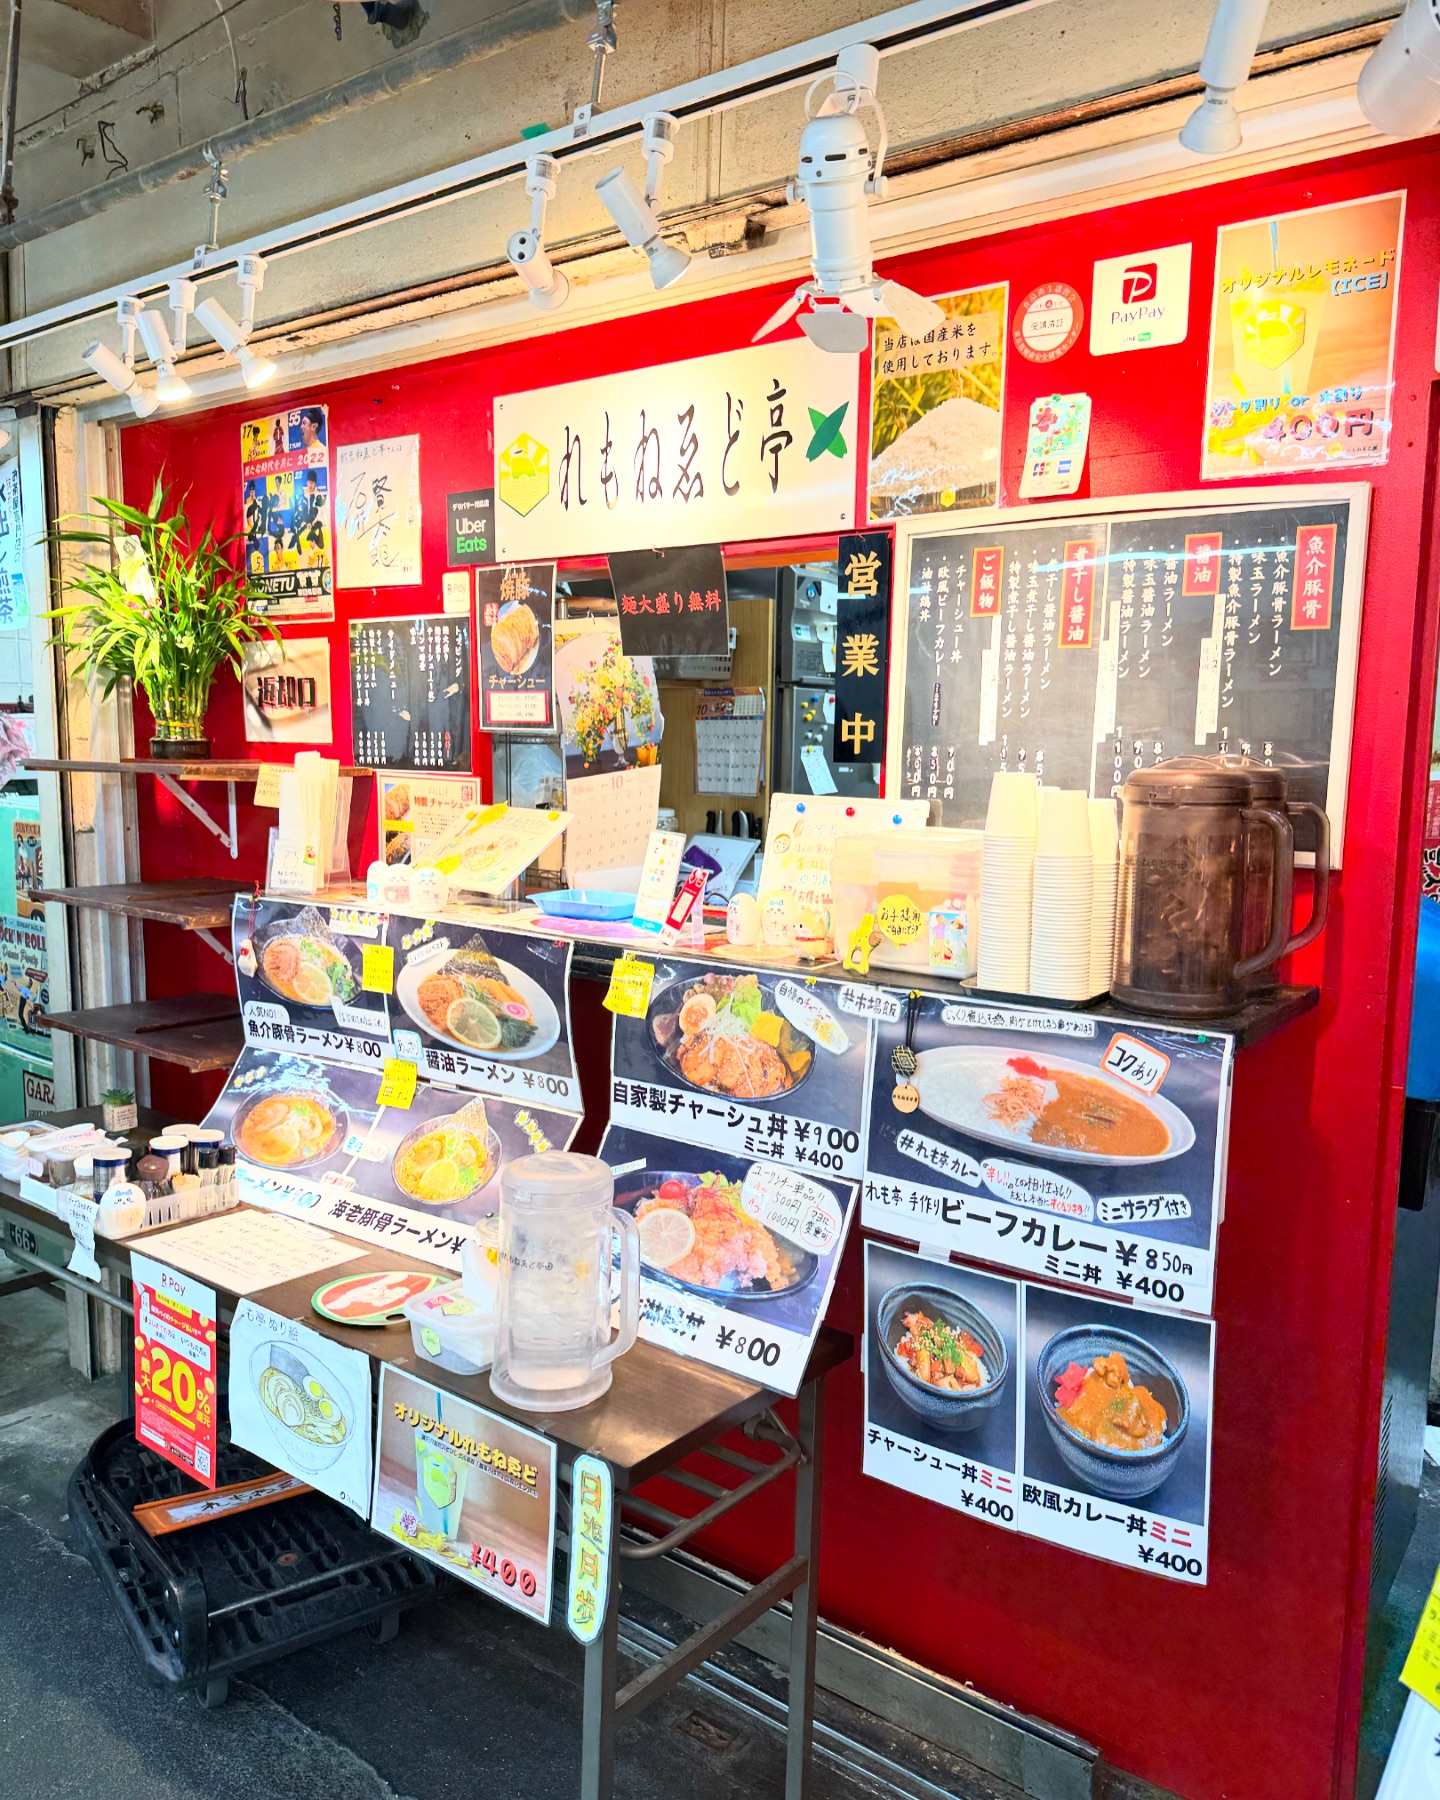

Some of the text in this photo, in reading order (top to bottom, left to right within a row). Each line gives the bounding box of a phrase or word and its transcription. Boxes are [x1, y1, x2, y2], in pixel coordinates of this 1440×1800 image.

[1221, 249, 1396, 293] オリジナルレモネード
[1111, 305, 1166, 325] PayPay
[883, 323, 977, 352] 当店は国産米を
[882, 342, 997, 374] 使用しております。
[1290, 395, 1309, 407] or
[243, 425, 252, 439] 17
[288, 411, 301, 426] 55
[1263, 408, 1374, 442] 400円
[297, 452, 324, 466] 2022
[559, 379, 793, 511] れもねゑど亭
[456, 518, 486, 535] Uber
[457, 537, 487, 553] Eats
[978, 555, 997, 609] ご飯物
[1068, 546, 1089, 642] 煮干し醤油
[1302, 535, 1326, 620] 魚介豚骨
[621, 590, 722, 615] 麺大盛り無料
[1248, 550, 1268, 645] 味玉ラーメン
[934, 562, 949, 677] 欧風ビーフカレー
[950, 565, 967, 664] チャーシュー丼
[842, 551, 882, 754] 営業中
[257, 677, 316, 708] 返却口
[489, 674, 545, 689] チャーシュー
[697, 704, 708, 715] 10
[611, 775, 623, 790] 10
[426, 1050, 515, 1083] 醤油ラーメン
[522, 1071, 569, 1097] ¥800
[1106, 1045, 1158, 1086] コクあり
[614, 1081, 859, 1153] 自家製チャーシュー丼 ¥900
[744, 1137, 843, 1171] ミニ丼 ¥400
[773, 1191, 801, 1214] 500円
[865, 1181, 902, 1206] れも亭
[908, 1192, 940, 1216] 手作り
[940, 1197, 1108, 1253] ビーフカレー
[1100, 1199, 1189, 1223] ミニサラダ付き
[767, 1211, 799, 1234] 1000円
[170, 1277, 186, 1297] Pay
[1044, 1254, 1185, 1302] ミニ丼 ¥400
[715, 1325, 781, 1367] ¥800
[394, 1402, 538, 1486] オリジナルれもねゑど
[961, 1490, 1014, 1523] ¥400
[470, 1542, 537, 1597] ¥400
[1137, 1544, 1202, 1577] ¥400
